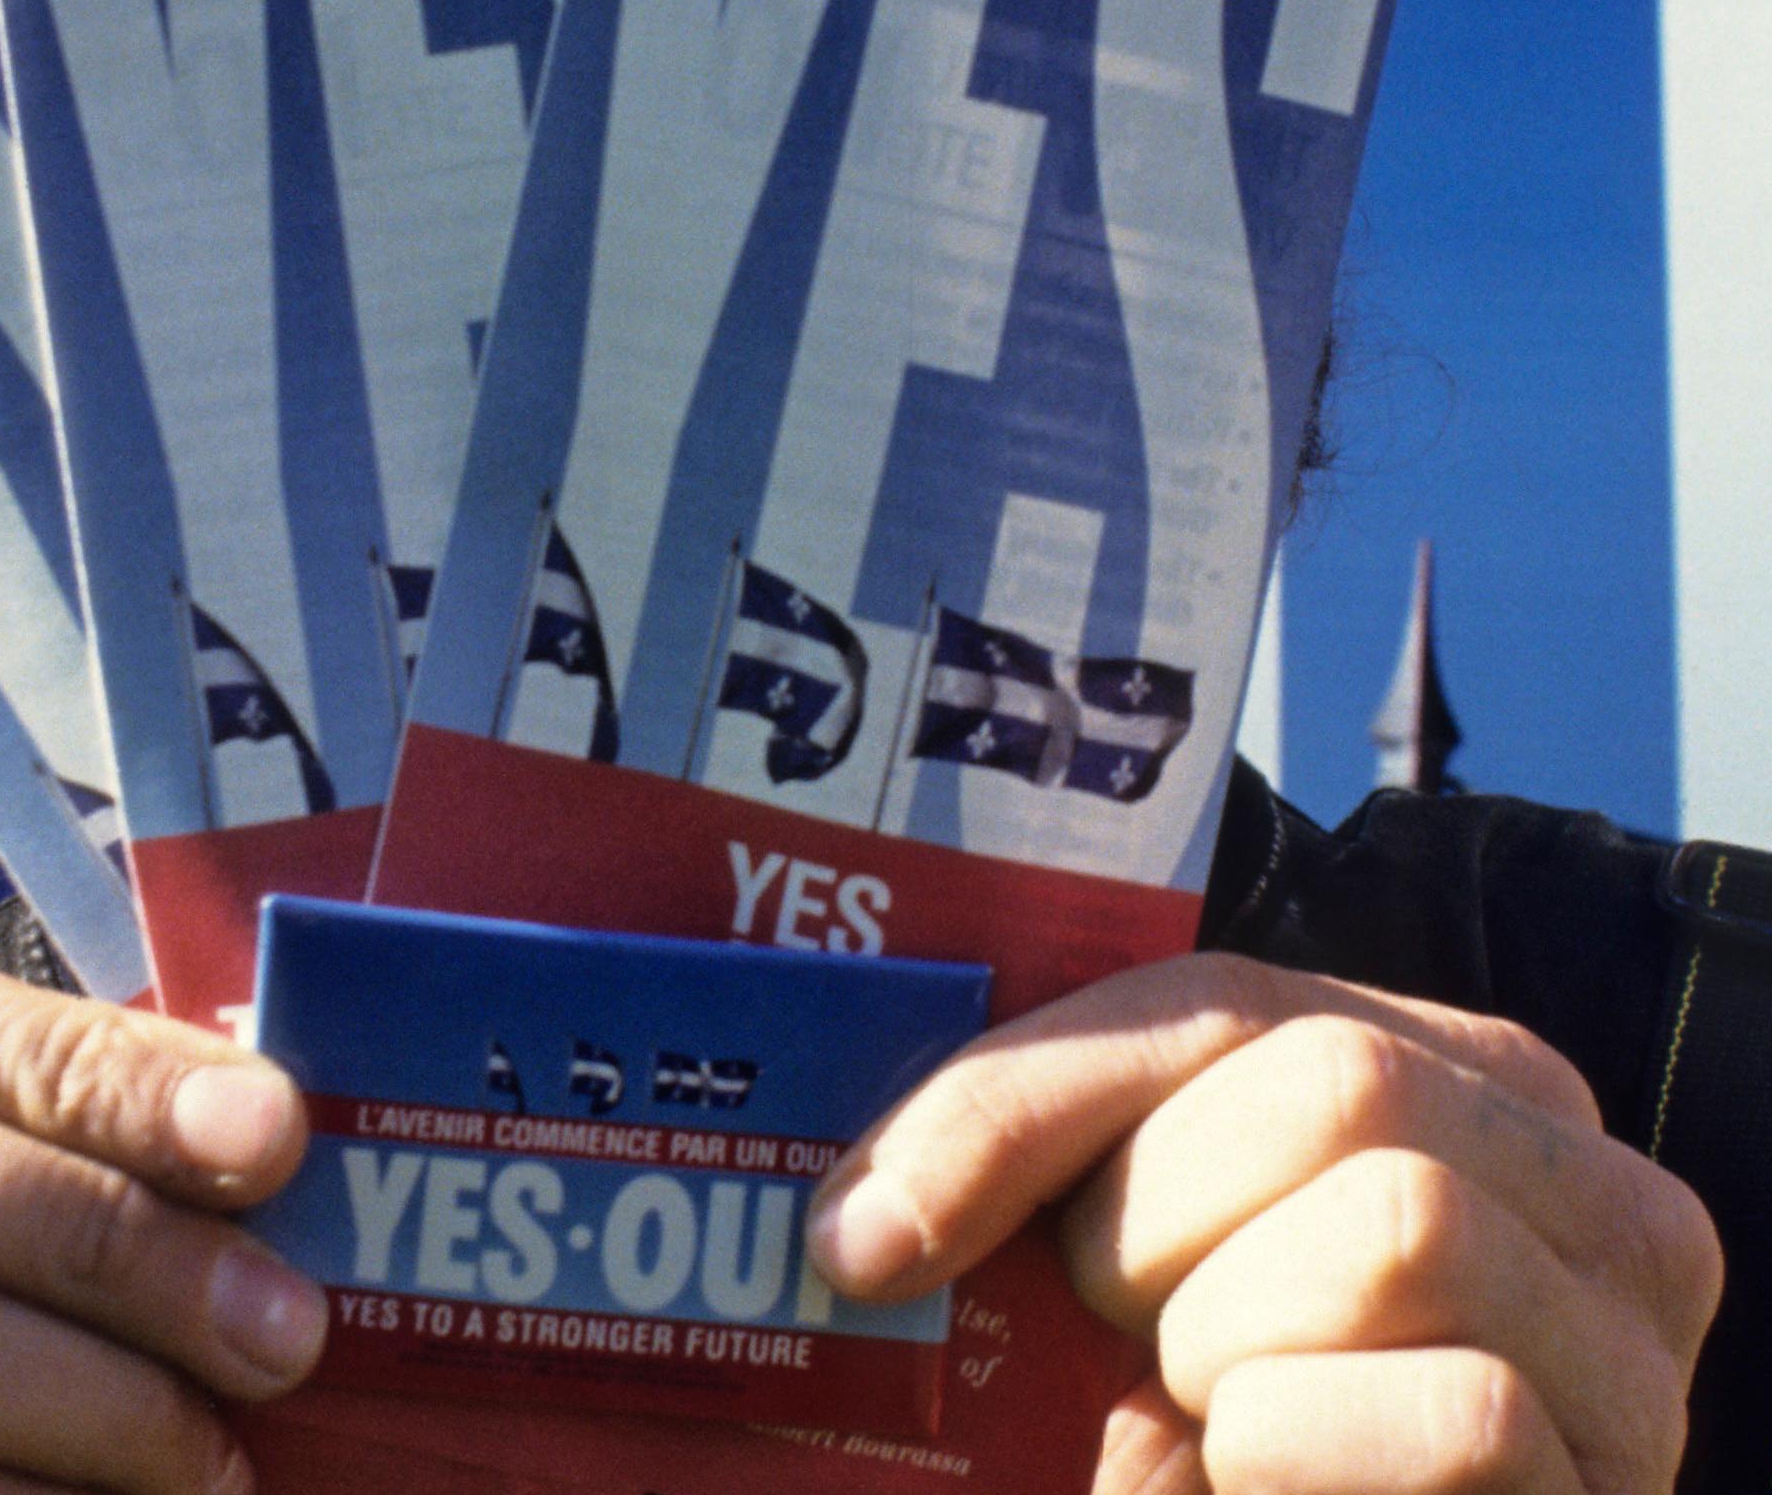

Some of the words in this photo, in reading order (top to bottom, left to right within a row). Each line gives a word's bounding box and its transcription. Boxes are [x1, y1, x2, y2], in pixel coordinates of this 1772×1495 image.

[727, 839, 892, 958] YES
[357, 1105, 486, 1145] L'AVENIR
[493, 1113, 661, 1157] COMMENCE
[670, 1130, 726, 1164] PAR
[735, 1137, 777, 1170] UN
[341, 1295, 399, 1331] YES
[414, 1302, 453, 1337] TO
[463, 1306, 485, 1339] A
[495, 1310, 674, 1355] STRONGER
[685, 1327, 812, 1369] FUTURE
[955, 1297, 1012, 1346] lse,
